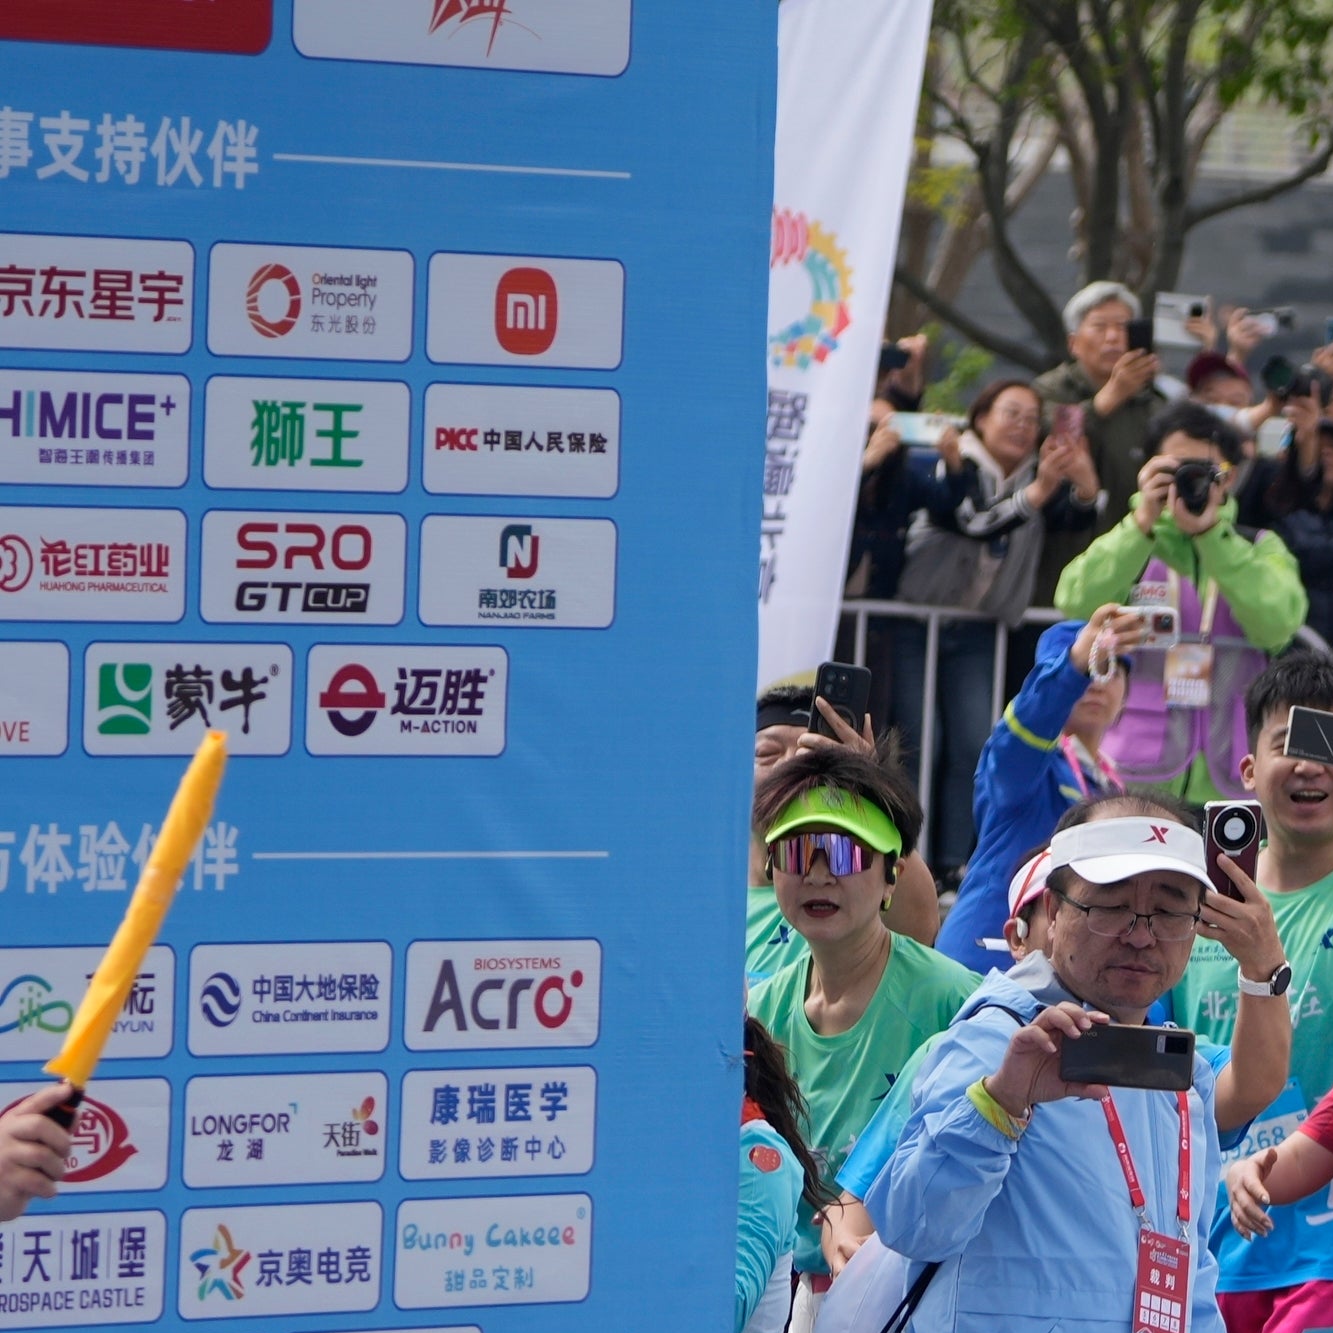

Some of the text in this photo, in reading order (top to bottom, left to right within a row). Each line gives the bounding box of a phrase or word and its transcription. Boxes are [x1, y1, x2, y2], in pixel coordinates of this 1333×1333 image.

[312, 288, 377, 309] Property
[310, 314, 377, 335] 东光股份
[434, 427, 608, 454] PICC 中国人民保险
[235, 522, 373, 571] SRO
[39, 581, 169, 594] HUAHONG PHARMACEUTICAL
[478, 588, 557, 610] 南郊农场
[165, 663, 270, 734] 蒙牛
[390, 666, 489, 717] 迈胜
[399, 719, 478, 735] M-ACTION
[474, 957, 561, 970] BIOSYSTEMS
[252, 974, 380, 1002] 中国大地保险
[252, 1010, 281, 1023] China
[330, 1010, 378, 1022] Insurance
[430, 1081, 568, 1126] 康瑞医学
[191, 1112, 290, 1136] LONGFOR
[322, 1121, 361, 1149] 天街
[217, 1138, 264, 1162] 龙湖
[428, 1135, 567, 1164] 影像诊断中心
[402, 1223, 576, 1256] Bunny Cakeee
[0, 1227, 146, 1283] 天城堡
[255, 1245, 373, 1288] 京奥电竞
[444, 1265, 535, 1292] 甜品定制
[80, 1287, 146, 1309] CASTLE
